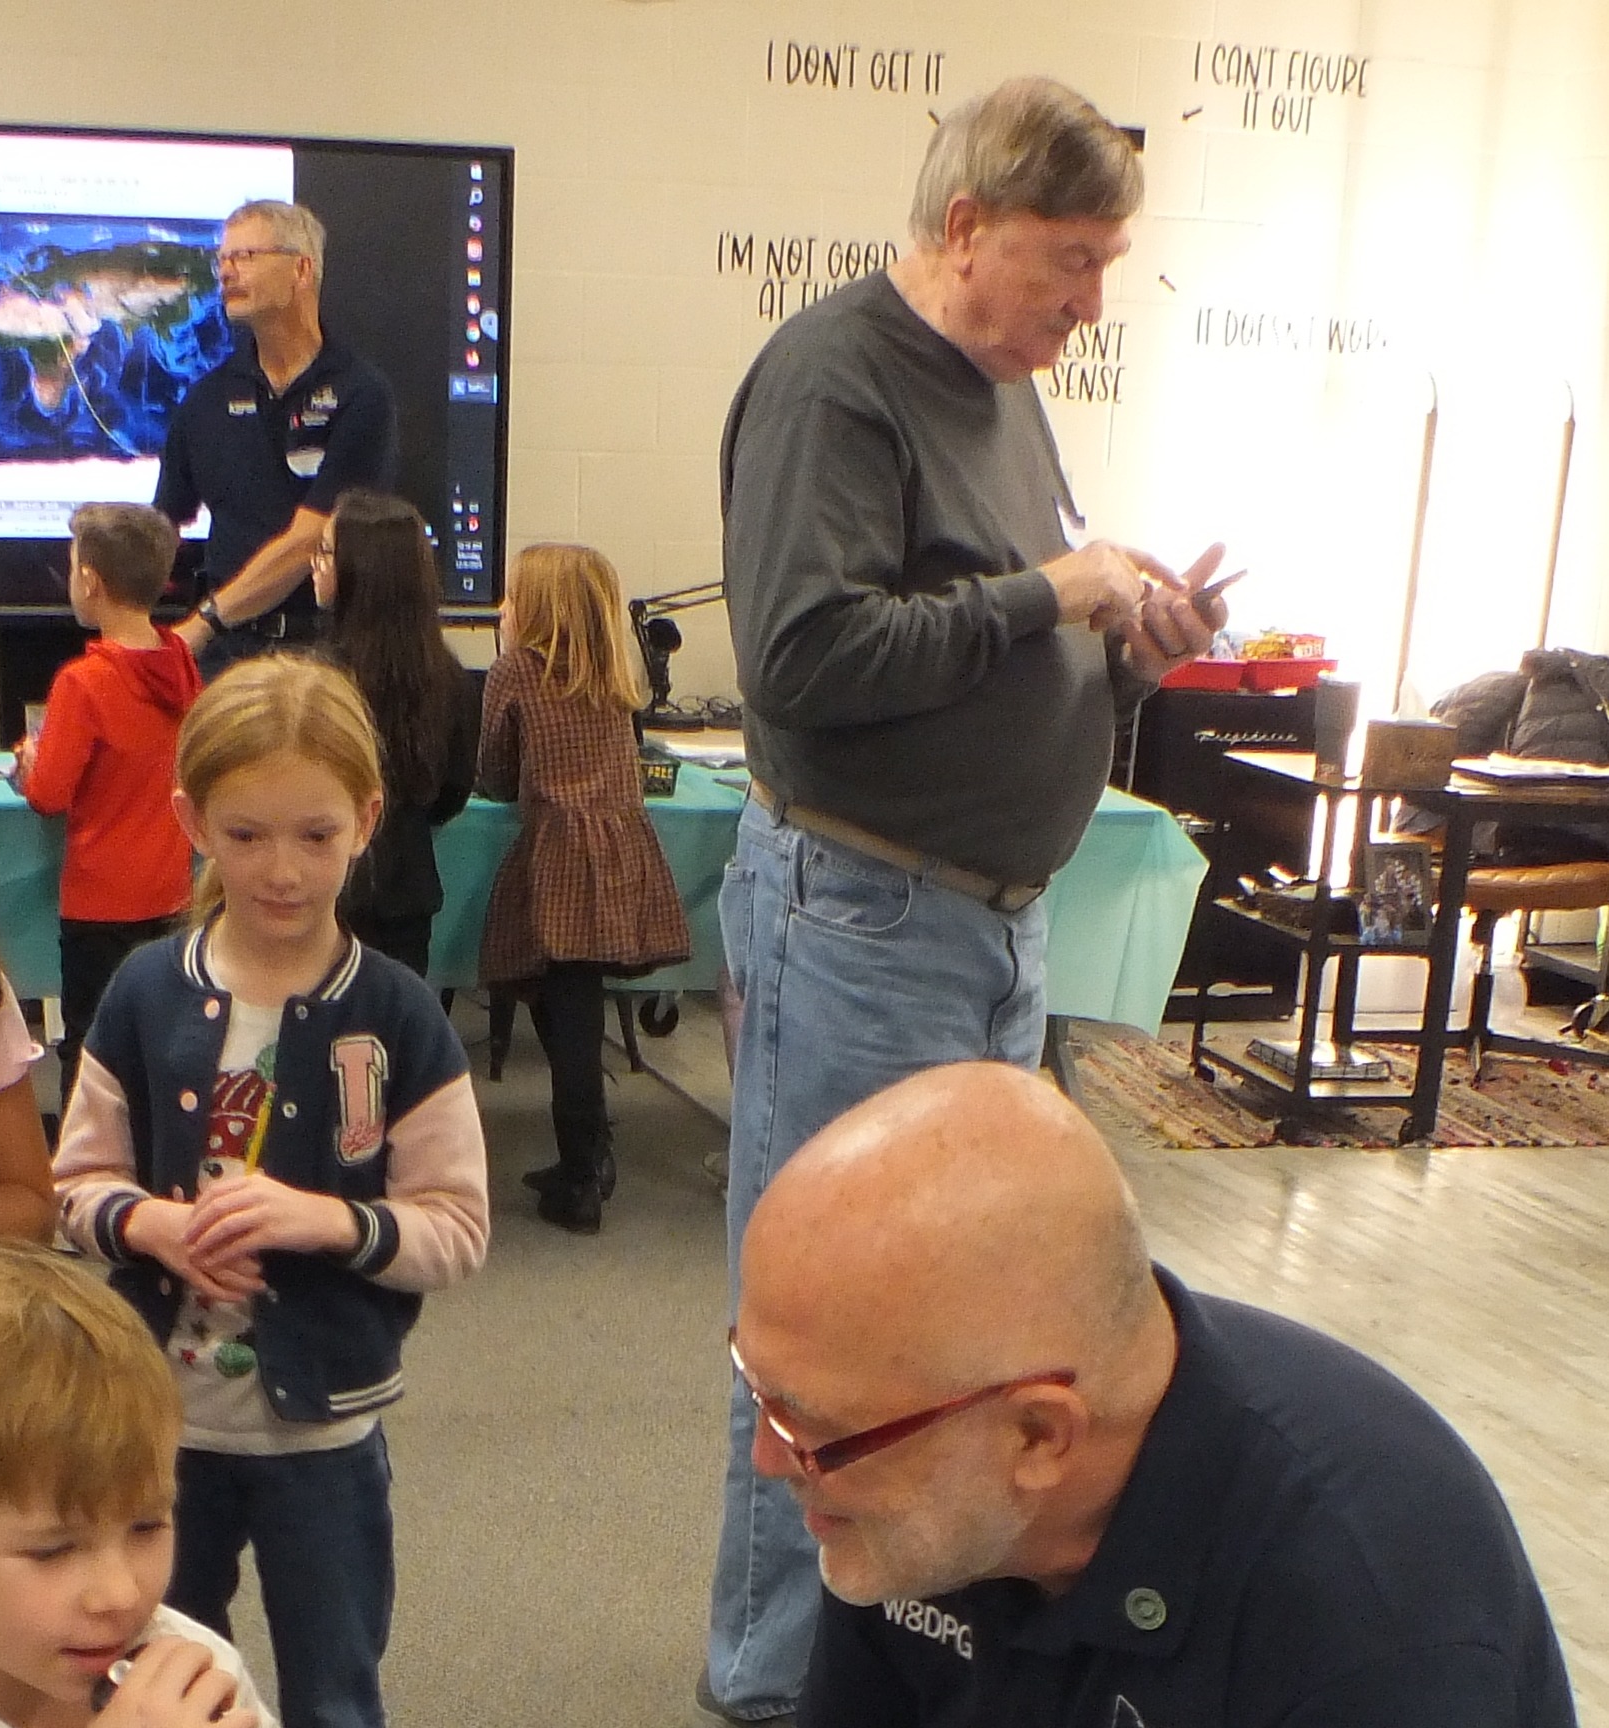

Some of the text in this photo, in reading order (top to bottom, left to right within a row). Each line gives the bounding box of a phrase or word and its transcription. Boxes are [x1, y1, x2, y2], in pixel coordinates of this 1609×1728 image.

[766, 40, 946, 96] I DON'T GET IT
[1193, 41, 1371, 98] I CAN'T FIGURE
[1242, 89, 1314, 135] IT OUT
[717, 230, 899, 281] I'M NOT GOOD
[759, 277, 789, 322] AT
[1196, 307, 1213, 345] IT
[1048, 361, 1127, 405] SENSE
[882, 1599, 973, 1661] W8DPG
